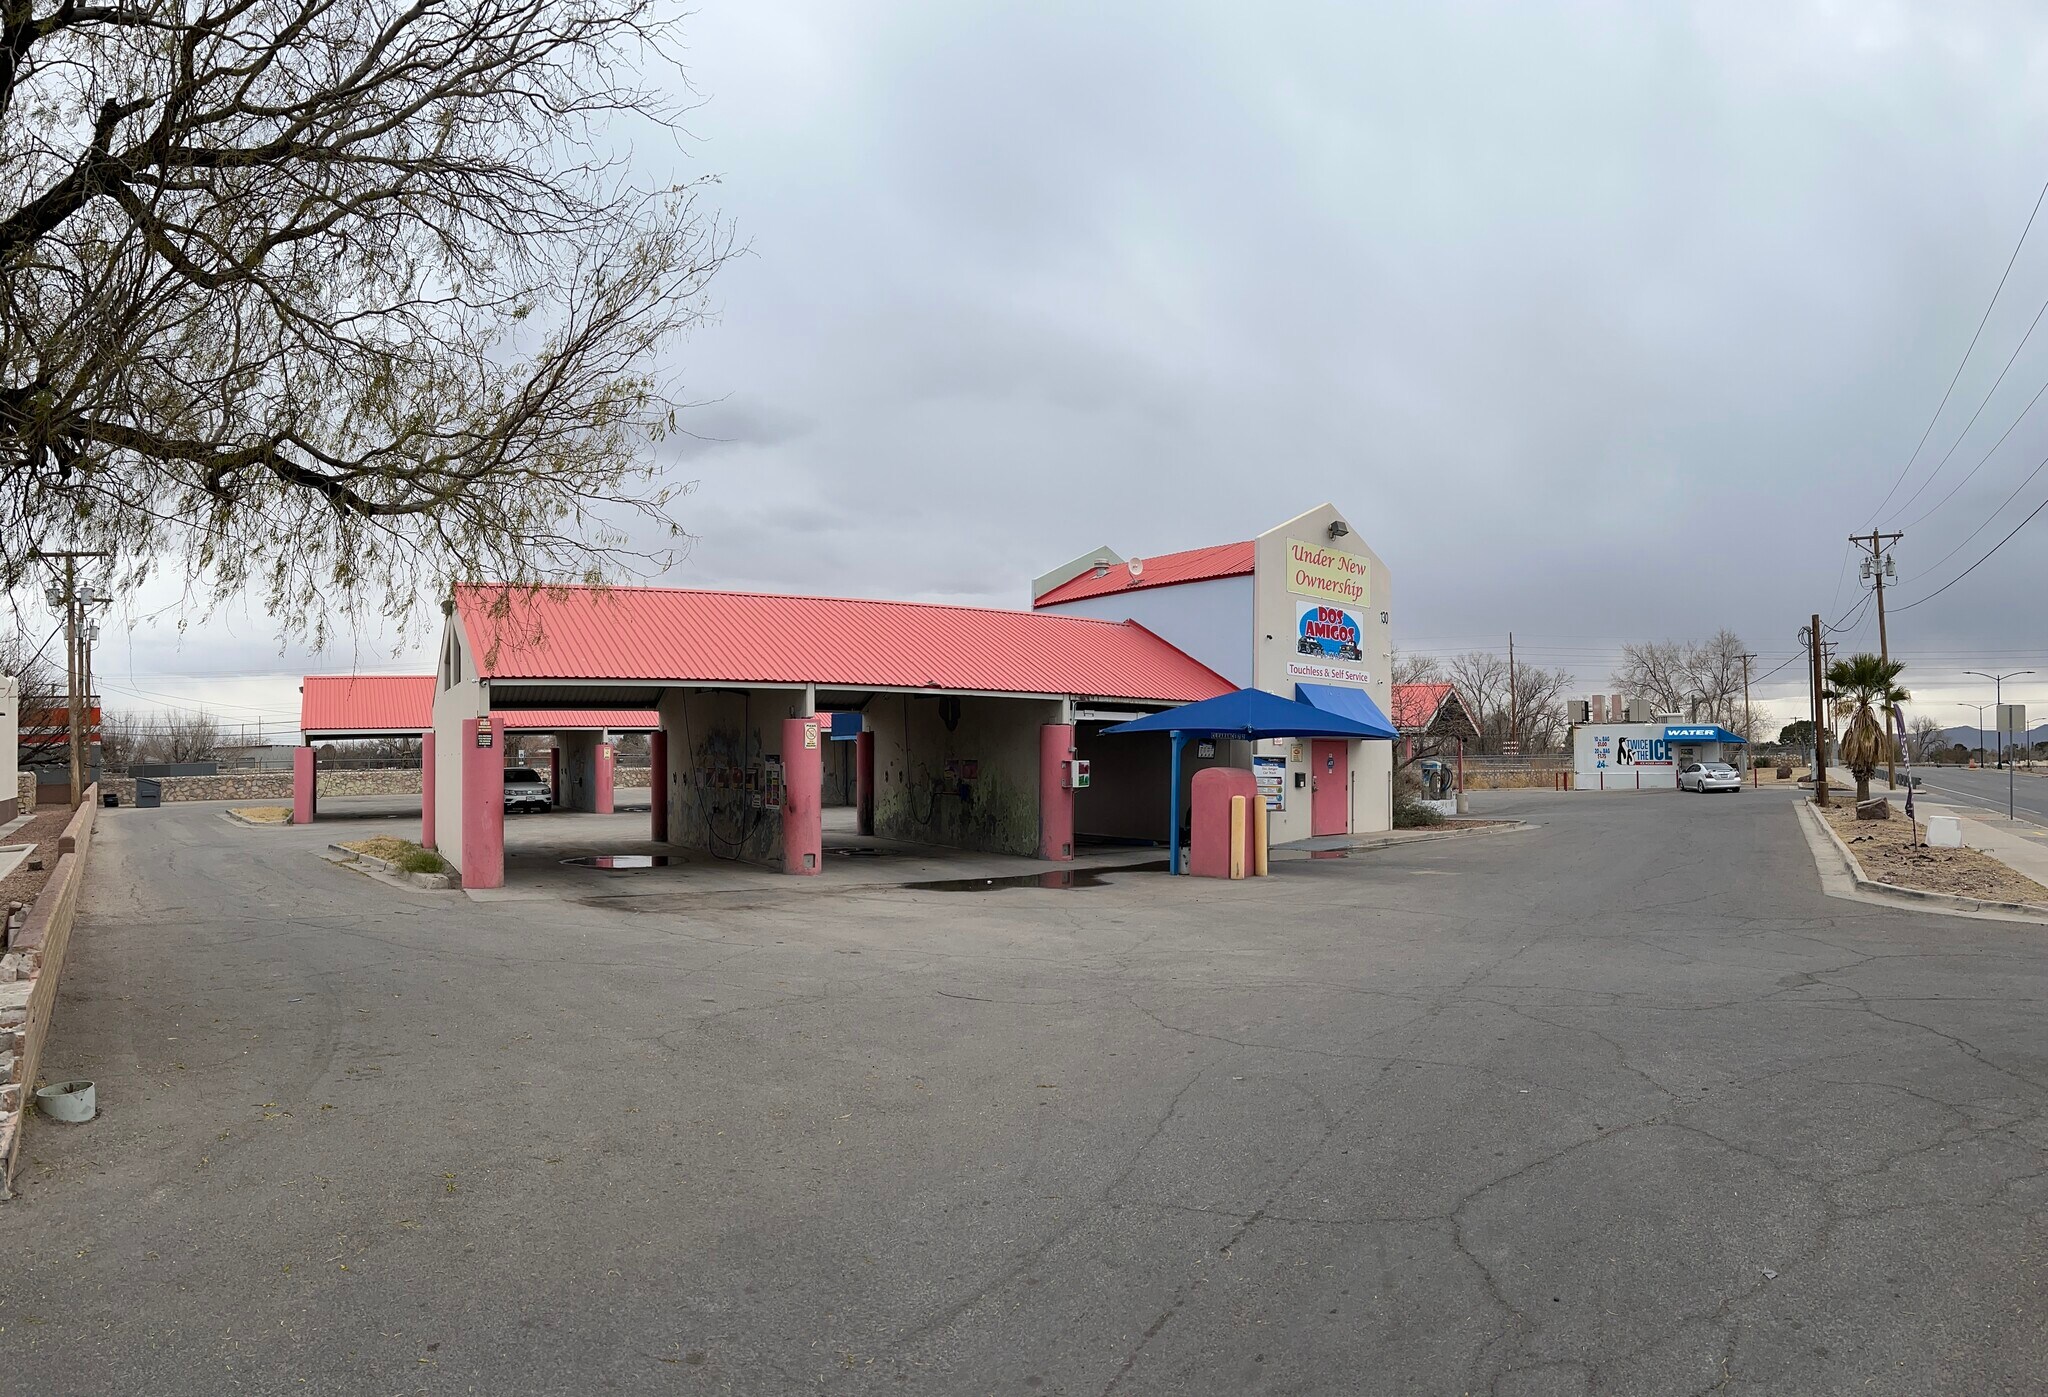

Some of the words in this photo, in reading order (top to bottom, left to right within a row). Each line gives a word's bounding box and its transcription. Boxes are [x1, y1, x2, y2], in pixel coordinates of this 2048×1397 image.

[1292, 544, 1334, 568] Under
[1338, 556, 1366, 576] New
[1296, 570, 1362, 602] Ownership
[1318, 606, 1344, 624] DOS
[1380, 611, 1388, 624] 130
[1306, 621, 1354, 642] AMIGOS
[1290, 664, 1323, 676] Touchless
[1324, 670, 1330, 678] &
[1332, 670, 1344, 678] Self
[1346, 672, 1368, 682] Service
[1626, 739, 1648, 750] TWICE
[1650, 739, 1672, 760] ICE
[1636, 750, 1648, 760] THE
